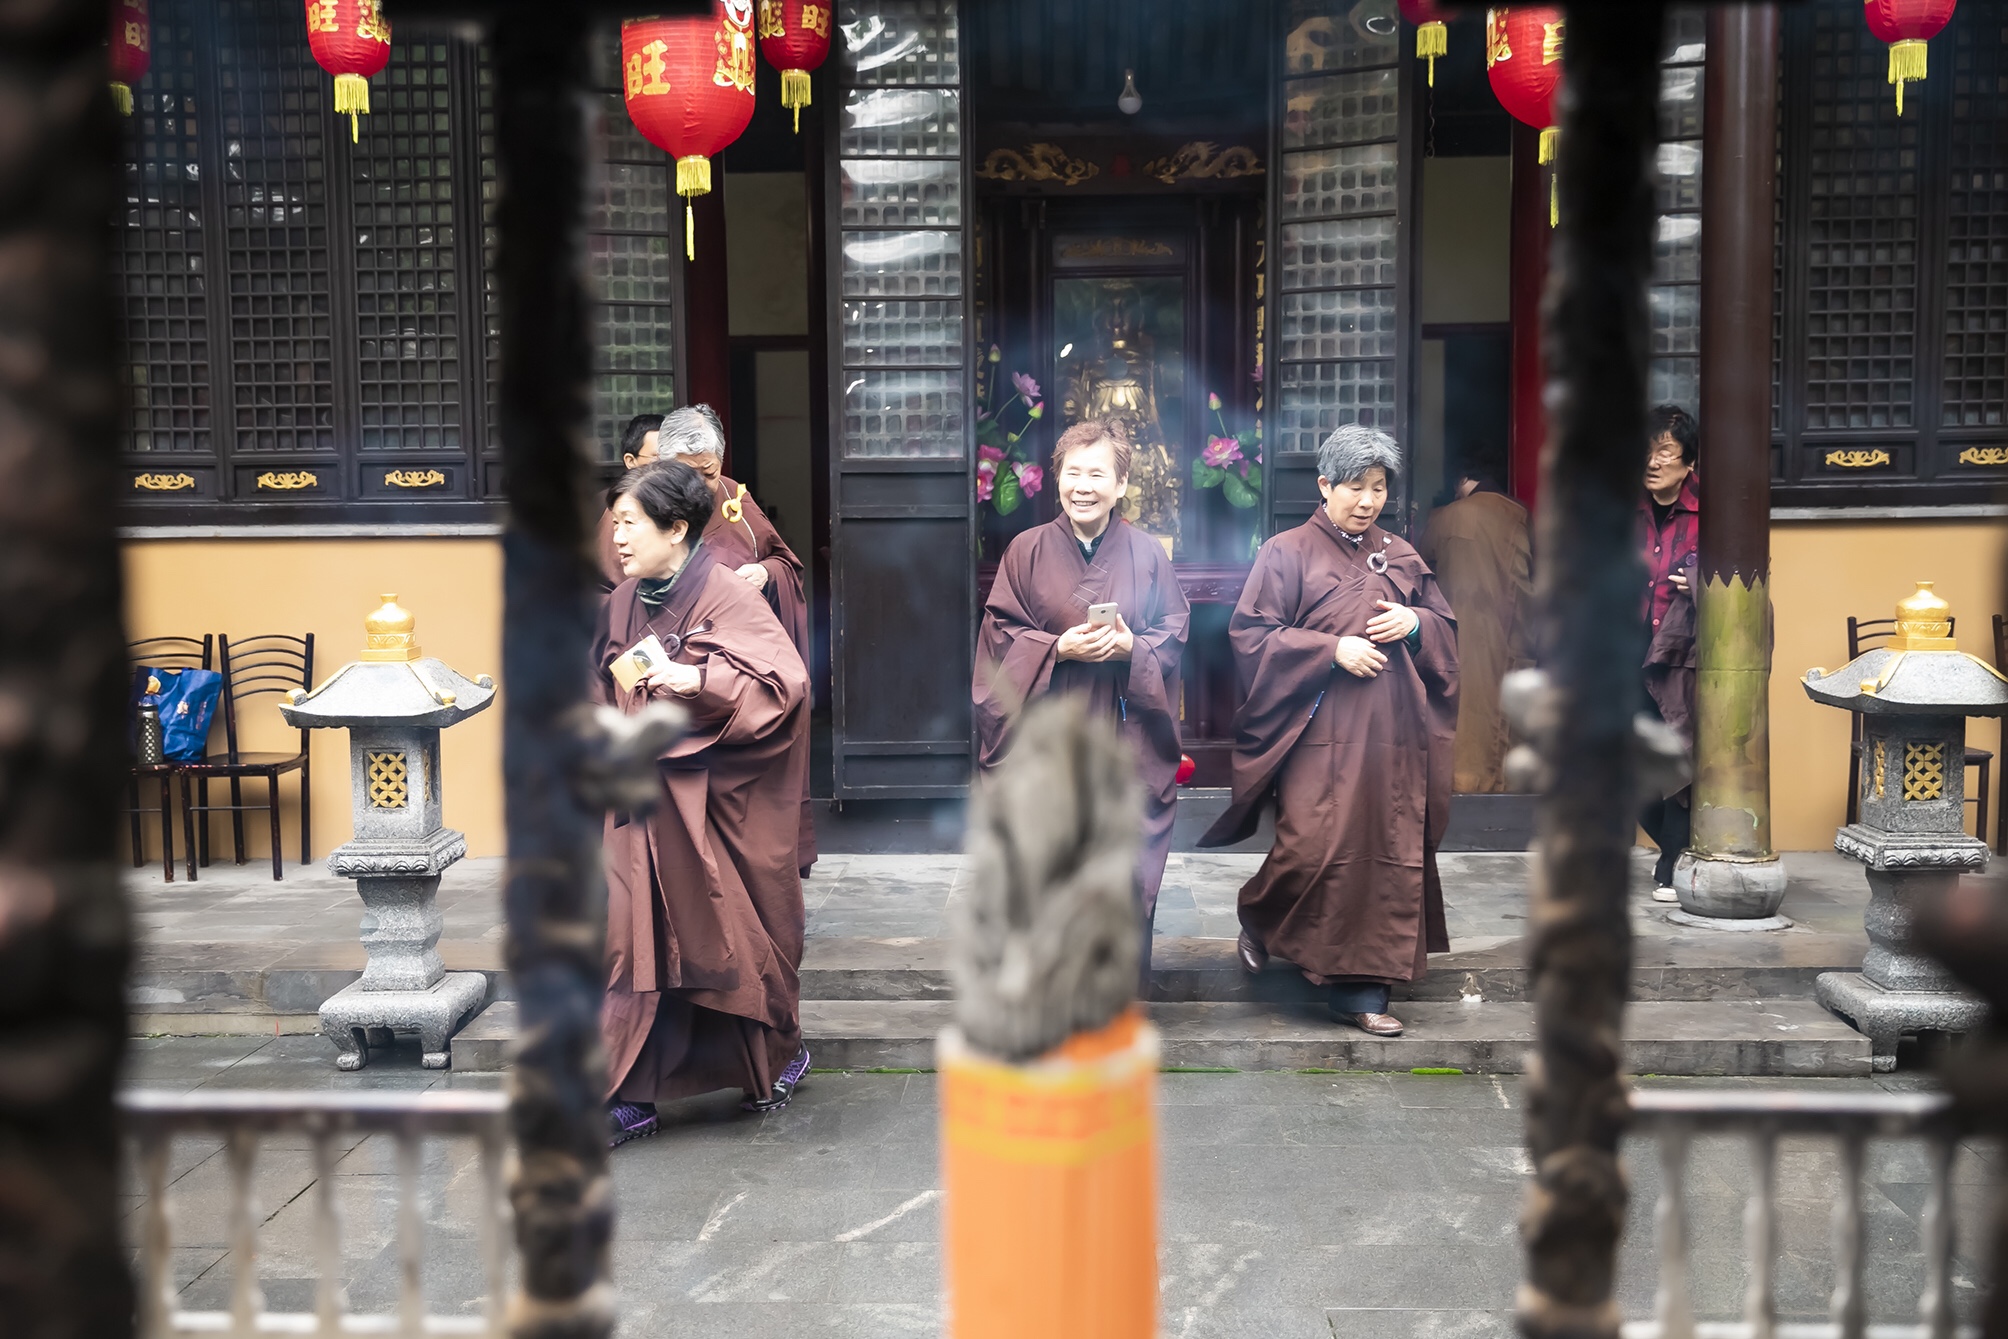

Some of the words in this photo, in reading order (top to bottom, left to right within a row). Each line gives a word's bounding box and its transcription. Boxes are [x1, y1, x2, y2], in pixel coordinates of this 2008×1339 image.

[308, 0, 339, 33] 旺
[801, 4, 830, 39] 旺
[626, 39, 671, 101] 旺
